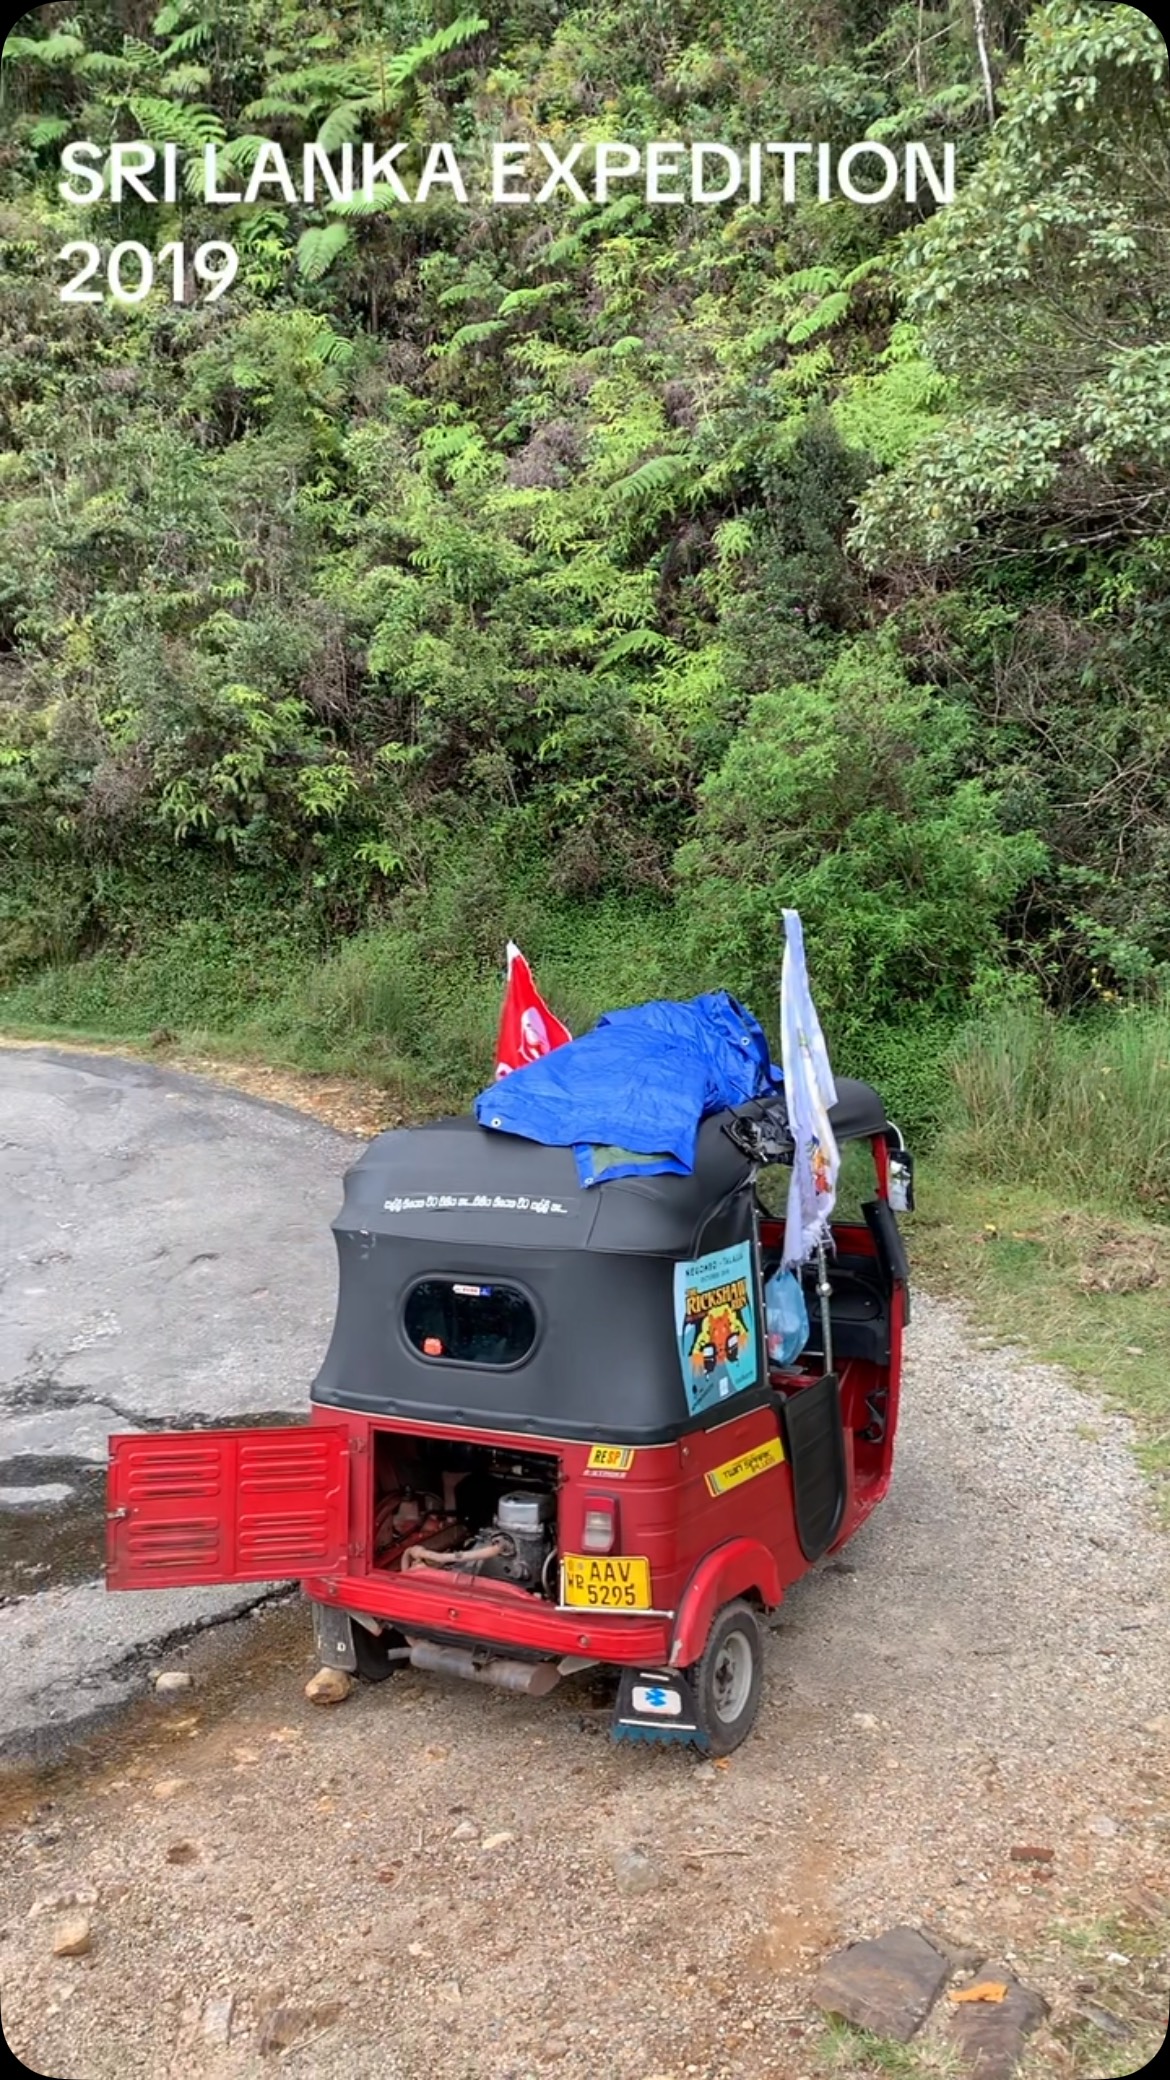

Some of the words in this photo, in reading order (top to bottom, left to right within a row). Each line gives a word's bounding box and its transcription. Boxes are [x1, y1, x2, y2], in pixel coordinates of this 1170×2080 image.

[686, 1279, 746, 1316] RICKSHAW
[589, 1561, 632, 1582] AAV
[586, 1583, 637, 1607] 5295
